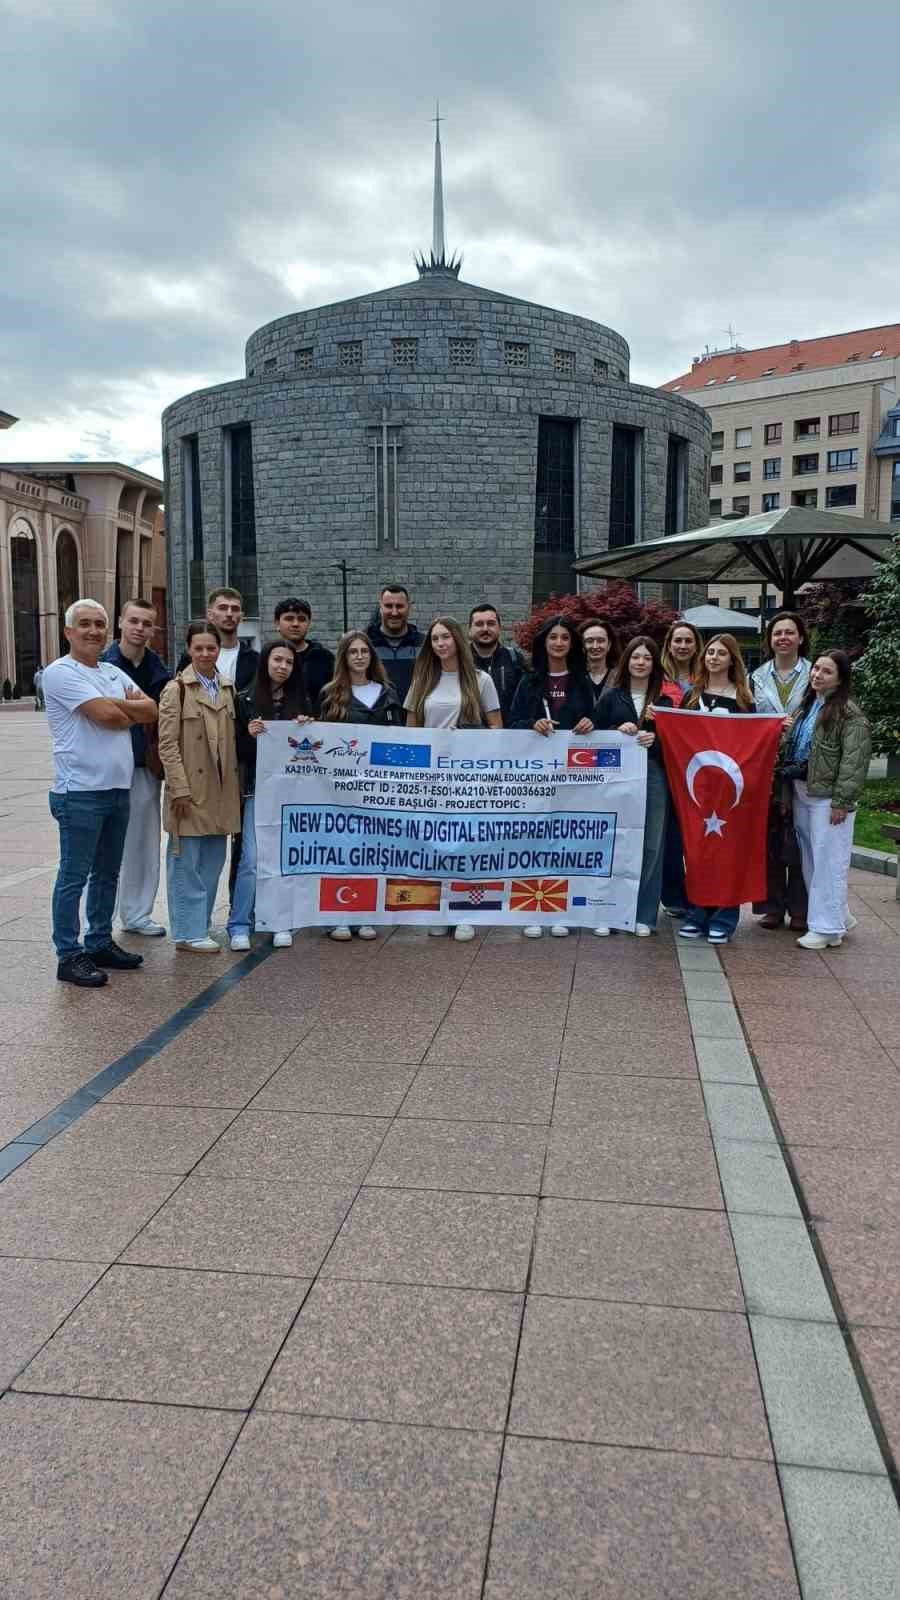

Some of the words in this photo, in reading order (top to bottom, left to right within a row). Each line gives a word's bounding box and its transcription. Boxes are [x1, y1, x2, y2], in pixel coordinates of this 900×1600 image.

[437, 756, 564, 770] Erasmus+
[285, 765, 328, 775] KA210-VET
[333, 768, 358, 777] SMALL
[364, 769, 388, 779] SCALE
[389, 771, 445, 782] PARTNERSHIPS
[454, 773, 502, 782] VOCATIONAL
[504, 774, 549, 782] EDUCATION
[551, 774, 567, 782] AND
[568, 774, 605, 783] TRAINING
[334, 781, 375, 791] PROJECT
[380, 782, 390, 793] ID
[362, 795, 397, 806] PROJE
[399, 797, 437, 809] BAŞLIĞI
[445, 799, 488, 809] PROJECT
[490, 799, 520, 809] TOPIC
[289, 812, 322, 834] NEW
[325, 812, 402, 838] DOCTRINES
[406, 819, 421, 840] IN
[423, 819, 475, 842] DIGITAL
[478, 818, 609, 842] ENTREPRENEURSHIP
[288, 840, 346, 867] DİJİTAL
[349, 841, 466, 873] GİRİŞİMCİLİKTE
[470, 848, 505, 873] YENİ
[508, 847, 603, 870] DOKTRİNLER
